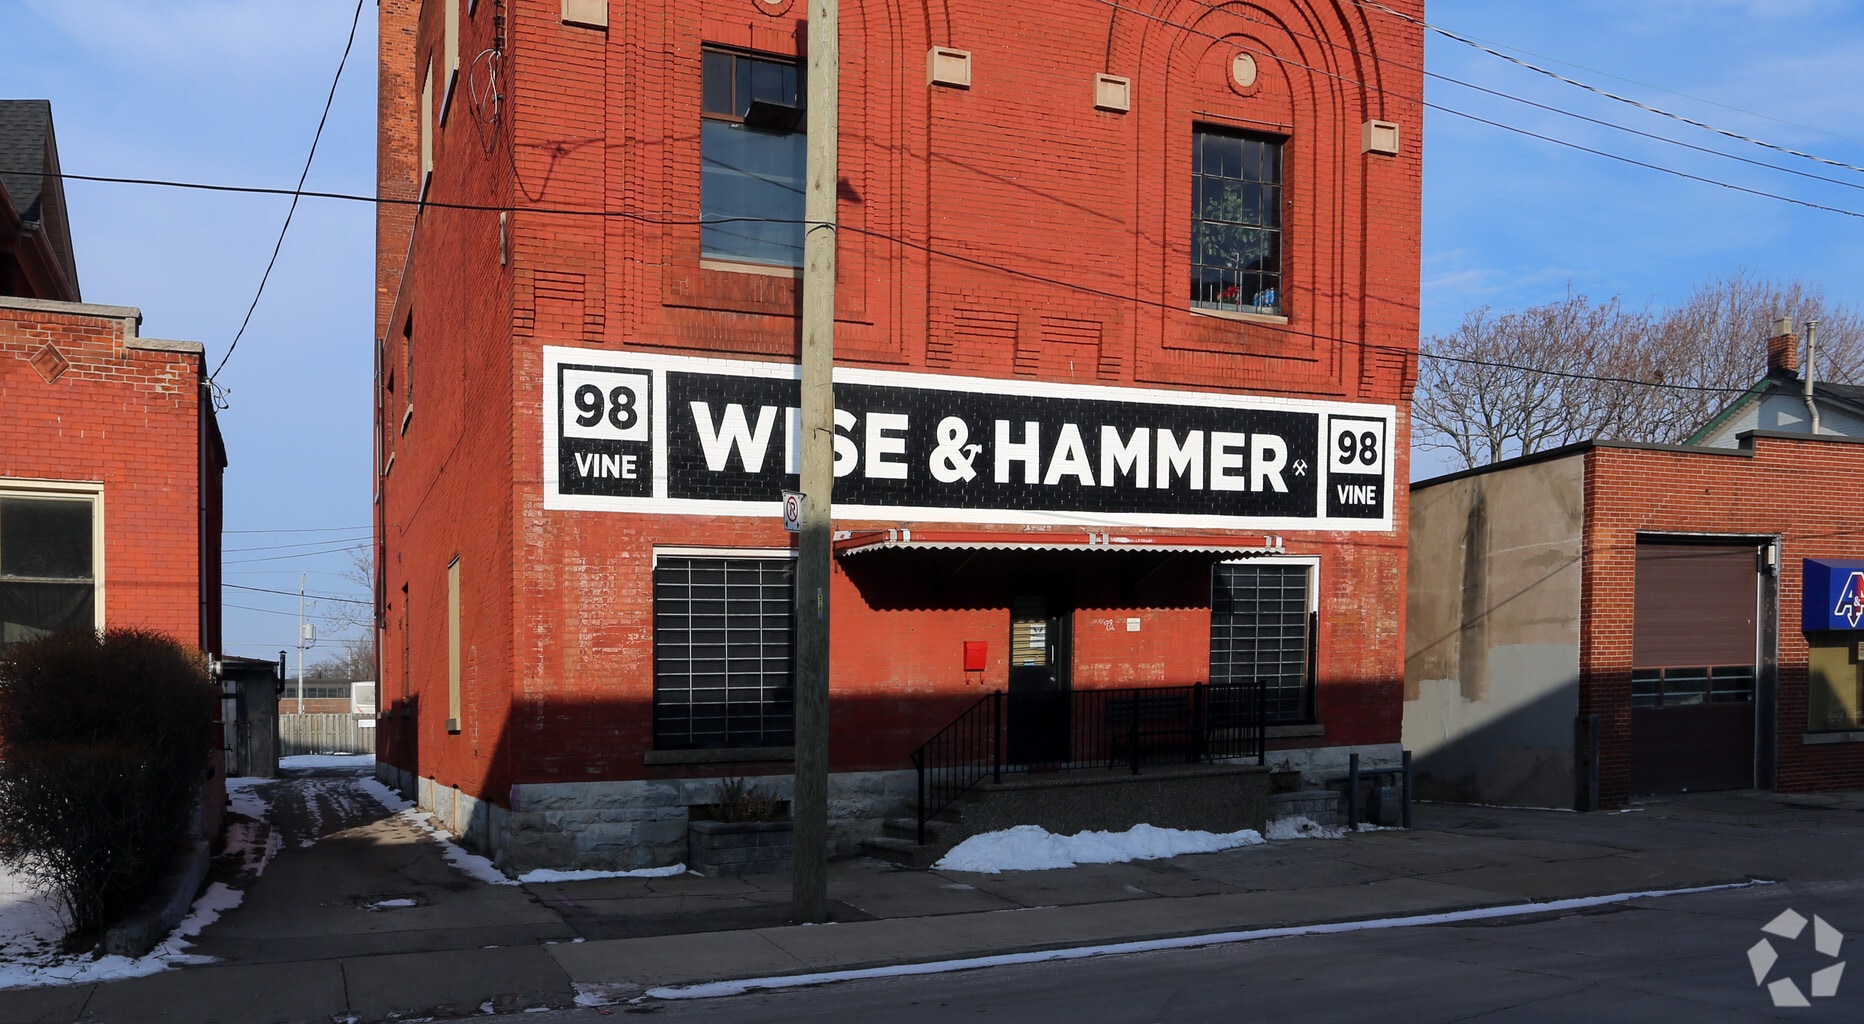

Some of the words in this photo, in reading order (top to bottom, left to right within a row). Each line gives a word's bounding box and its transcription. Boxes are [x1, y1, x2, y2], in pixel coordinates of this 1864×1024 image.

[574, 383, 638, 430] 98
[574, 452, 637, 479] VINE
[929, 416, 983, 483] &
[994, 419, 1289, 493] HAMMER
[1337, 430, 1378, 466] 98
[1337, 484, 1377, 505] VINE
